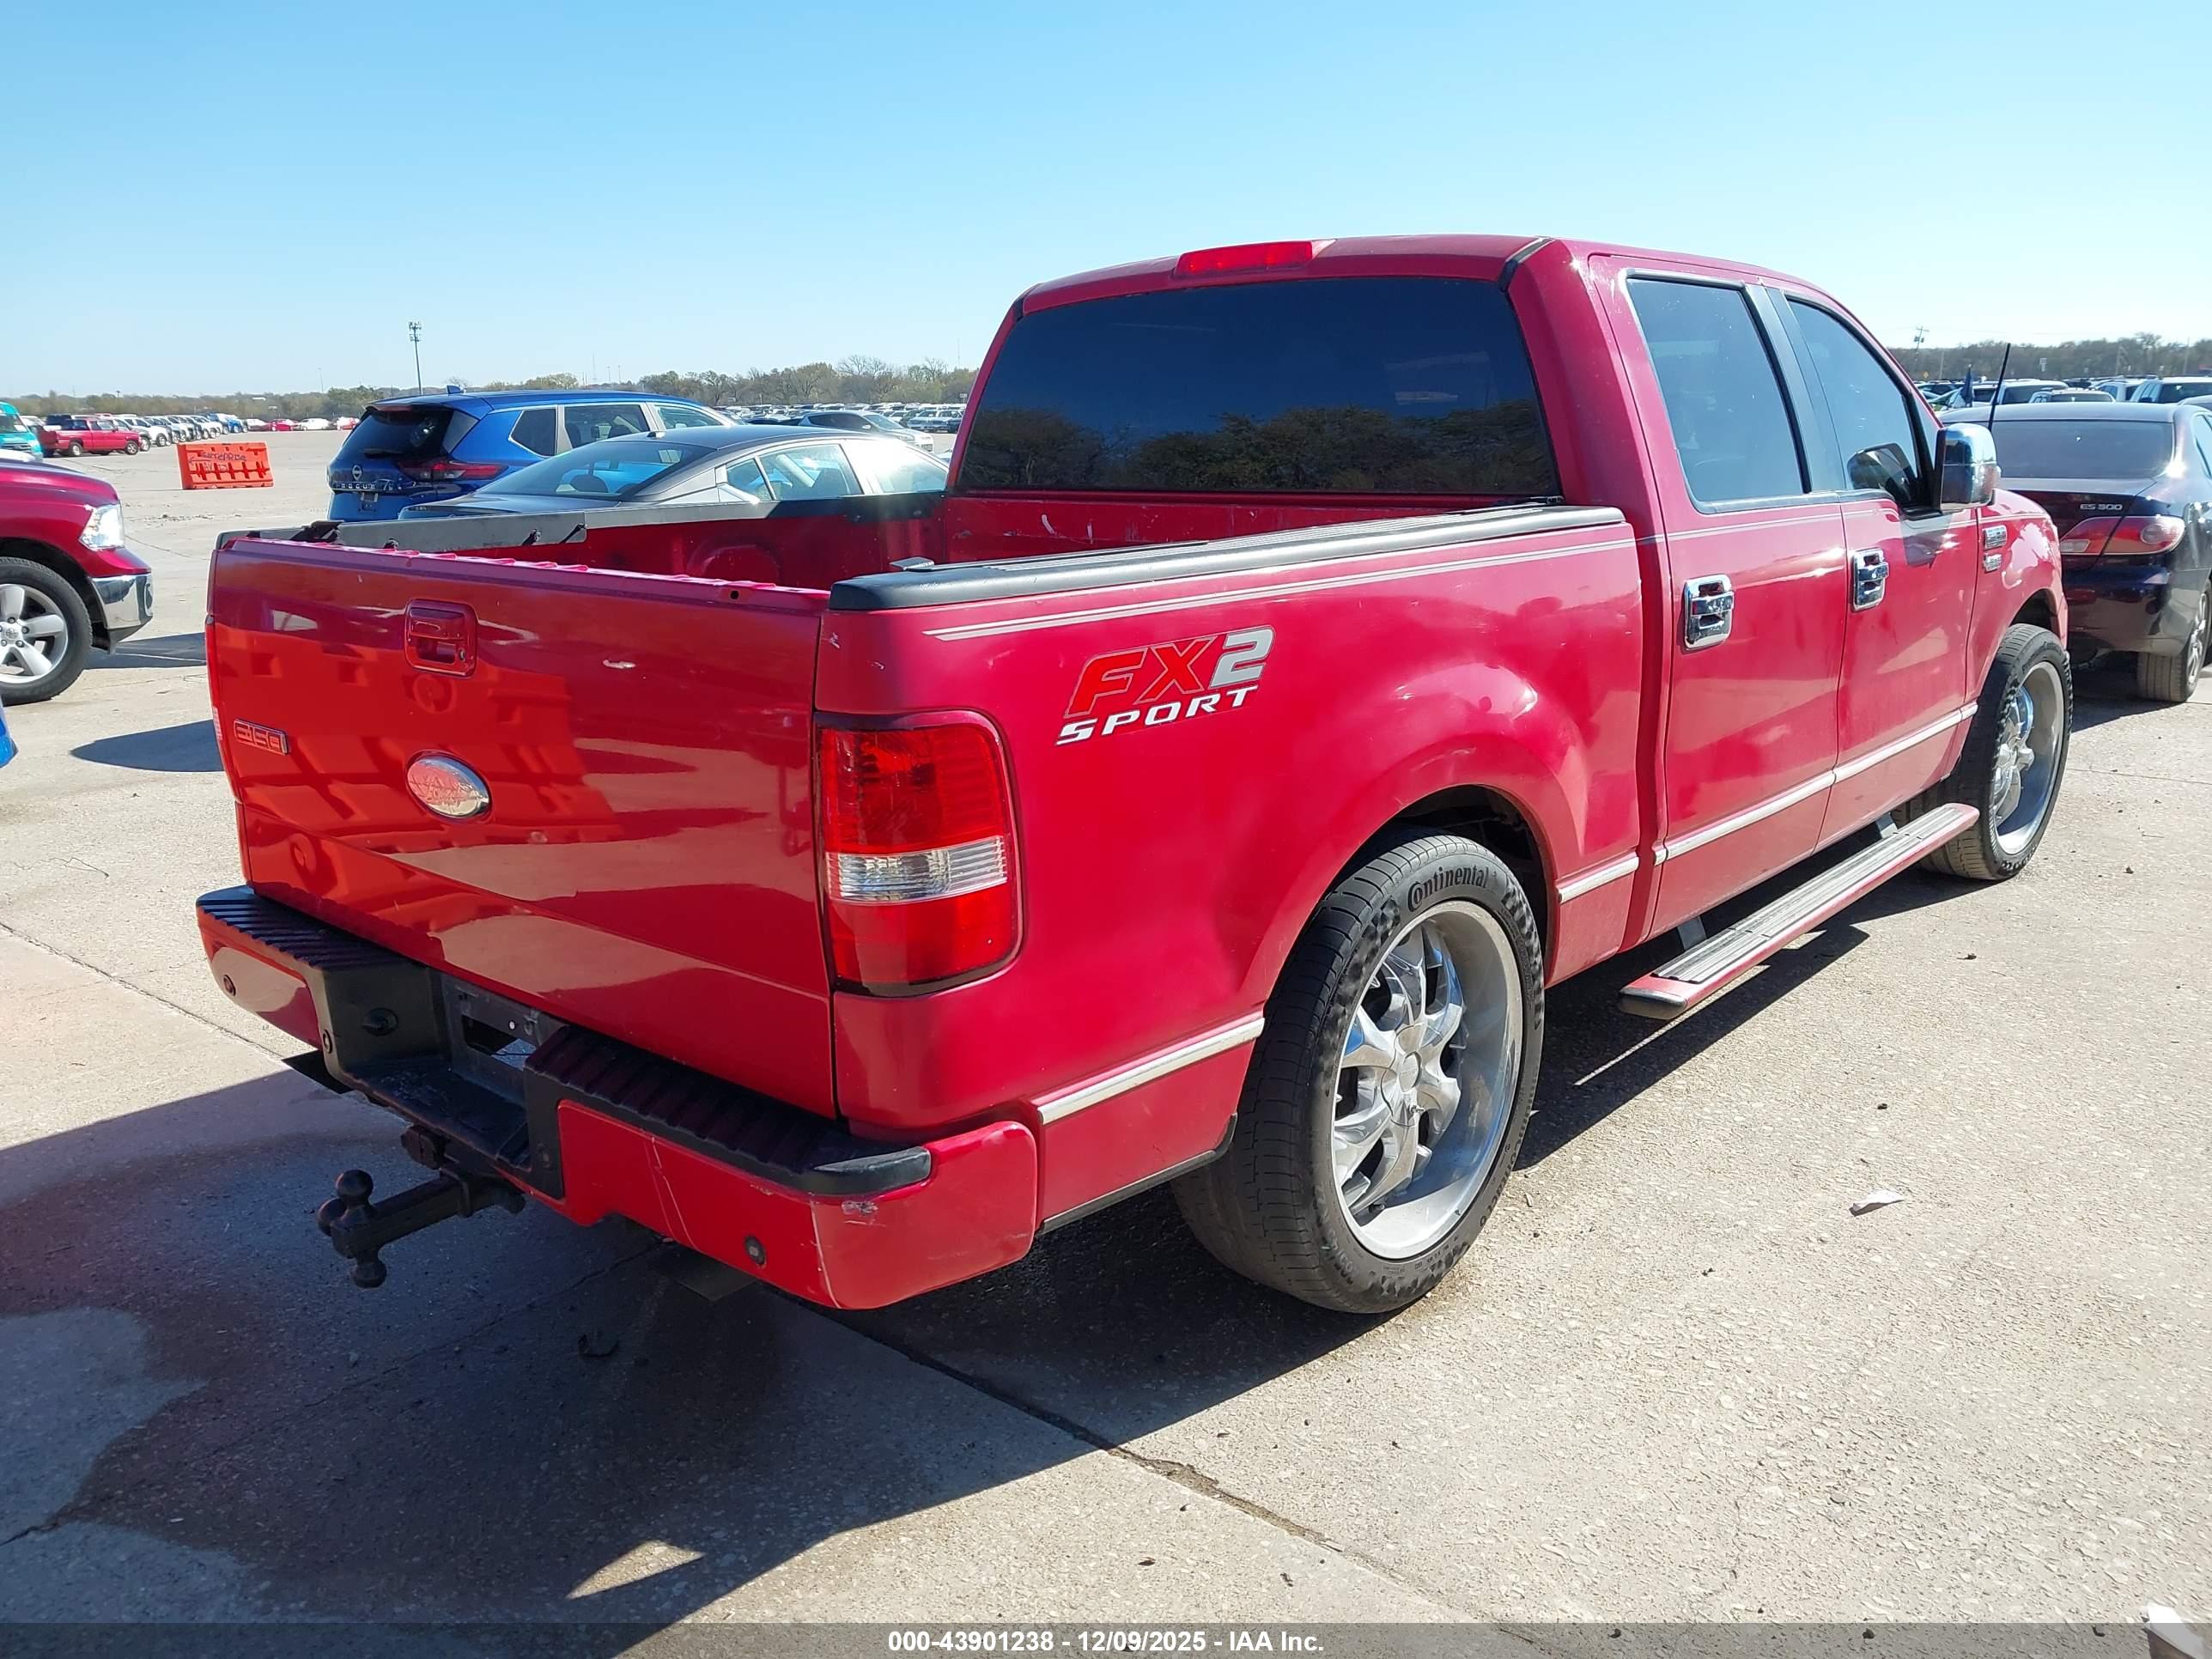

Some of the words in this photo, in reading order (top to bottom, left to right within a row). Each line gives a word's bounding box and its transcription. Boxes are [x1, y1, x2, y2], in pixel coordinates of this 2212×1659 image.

[1064, 625, 1276, 719] FX2
[1055, 685, 1259, 745] SPORT
[1407, 865, 1489, 912] Continental
